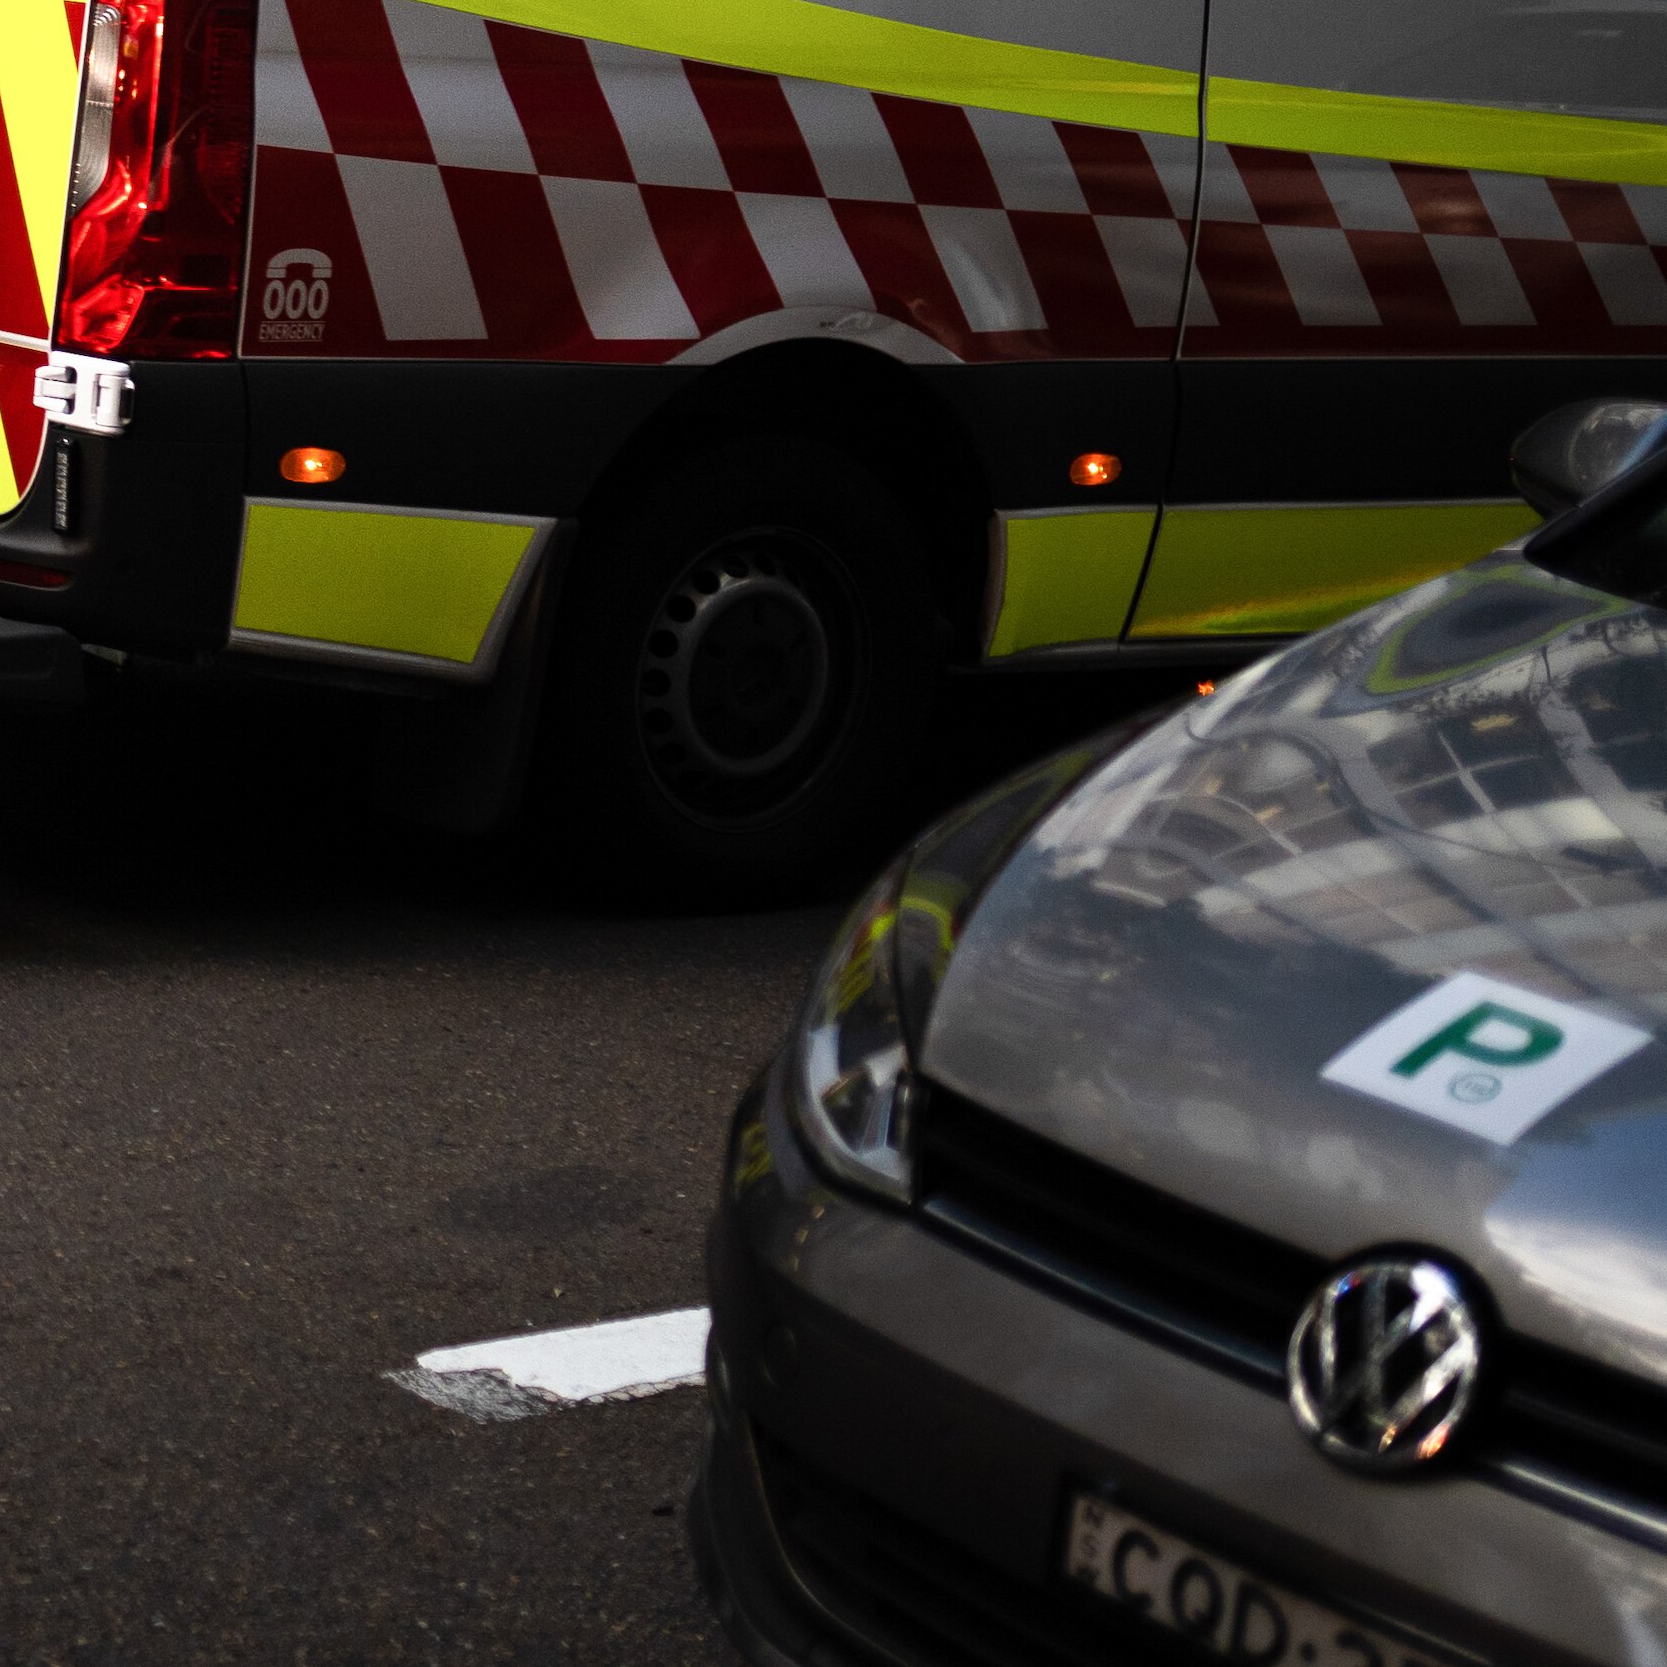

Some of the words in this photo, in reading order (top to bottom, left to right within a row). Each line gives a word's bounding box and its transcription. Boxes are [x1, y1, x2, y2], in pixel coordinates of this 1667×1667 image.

[263, 279, 329, 320] 000
[259, 323, 326, 341] EMERGENCY
[1389, 1000, 1565, 1080] P
